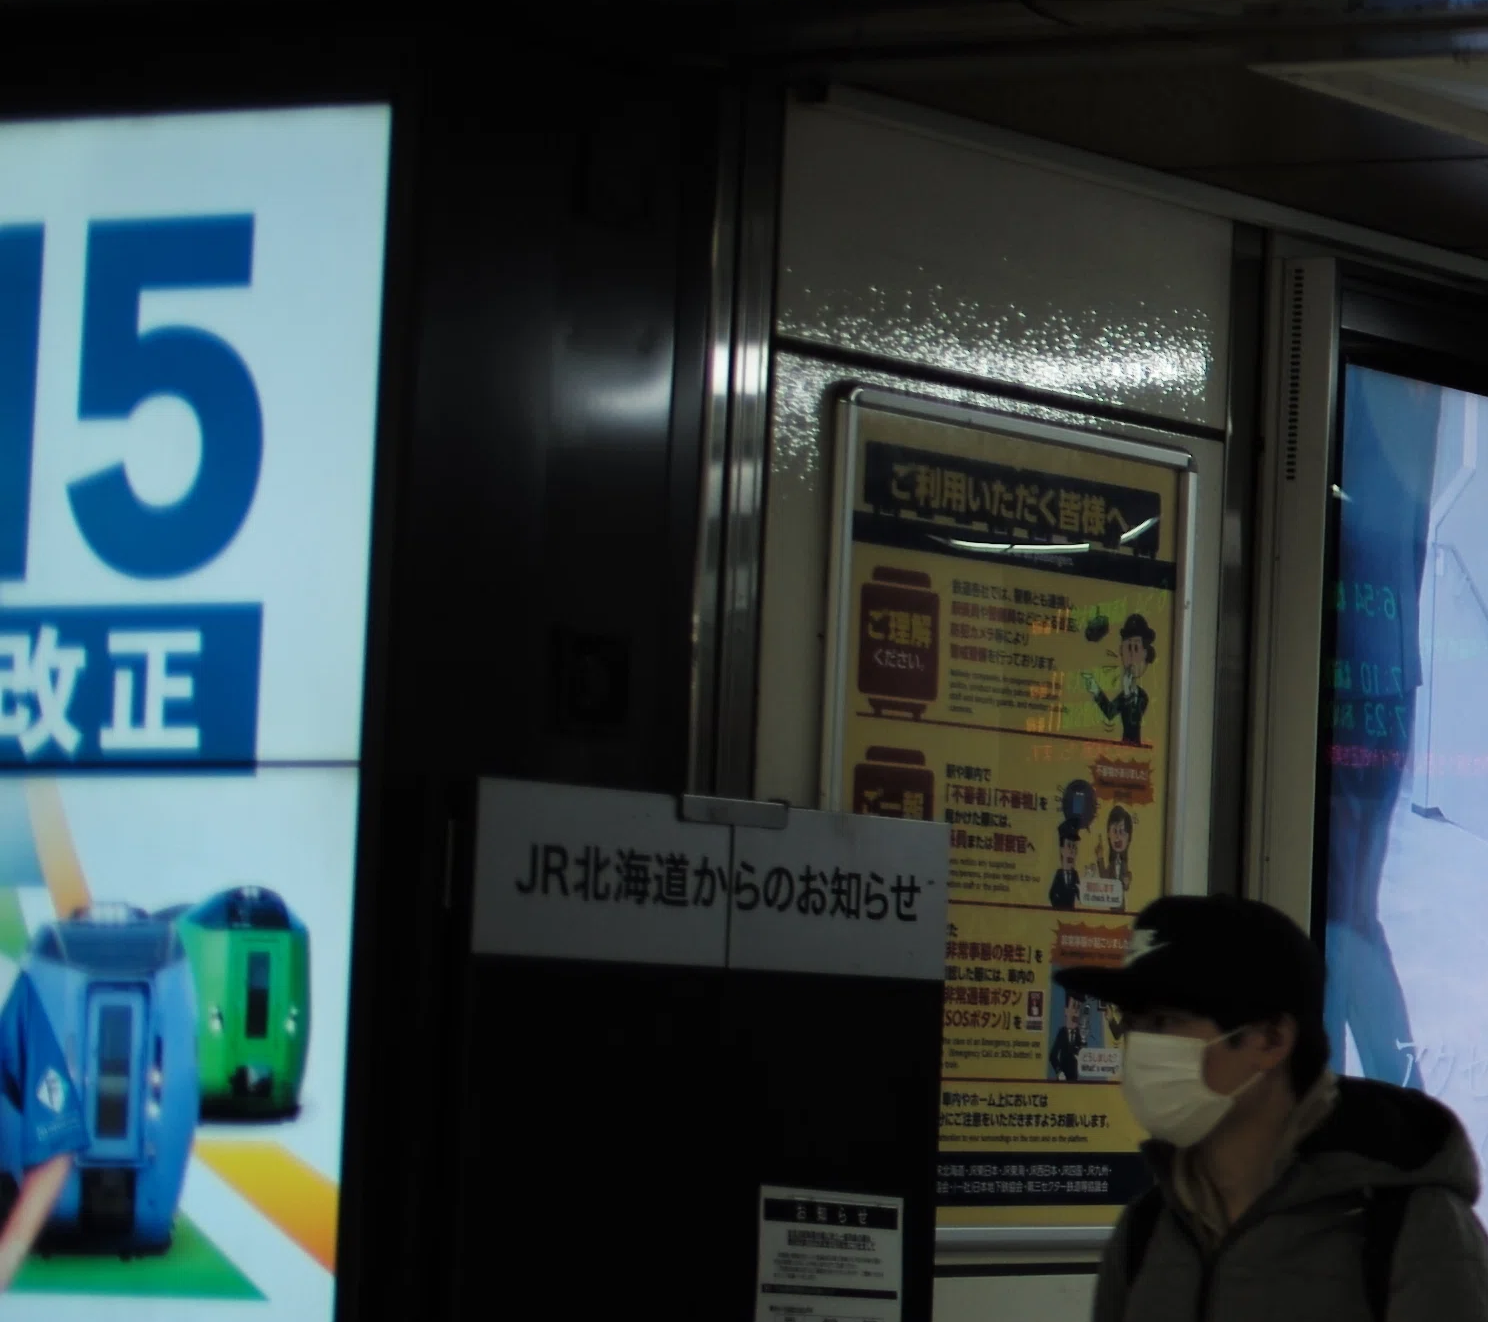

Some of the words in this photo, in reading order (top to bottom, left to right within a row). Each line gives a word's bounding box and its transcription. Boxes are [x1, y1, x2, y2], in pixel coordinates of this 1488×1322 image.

[890, 463, 1129, 536] ご利用いただく皆様へ
[867, 608, 932, 649] ご理解
[873, 649, 924, 671] ください。
[0, 623, 204, 761] 改正
[514, 843, 921, 923] JR北海道からのお知らせ
